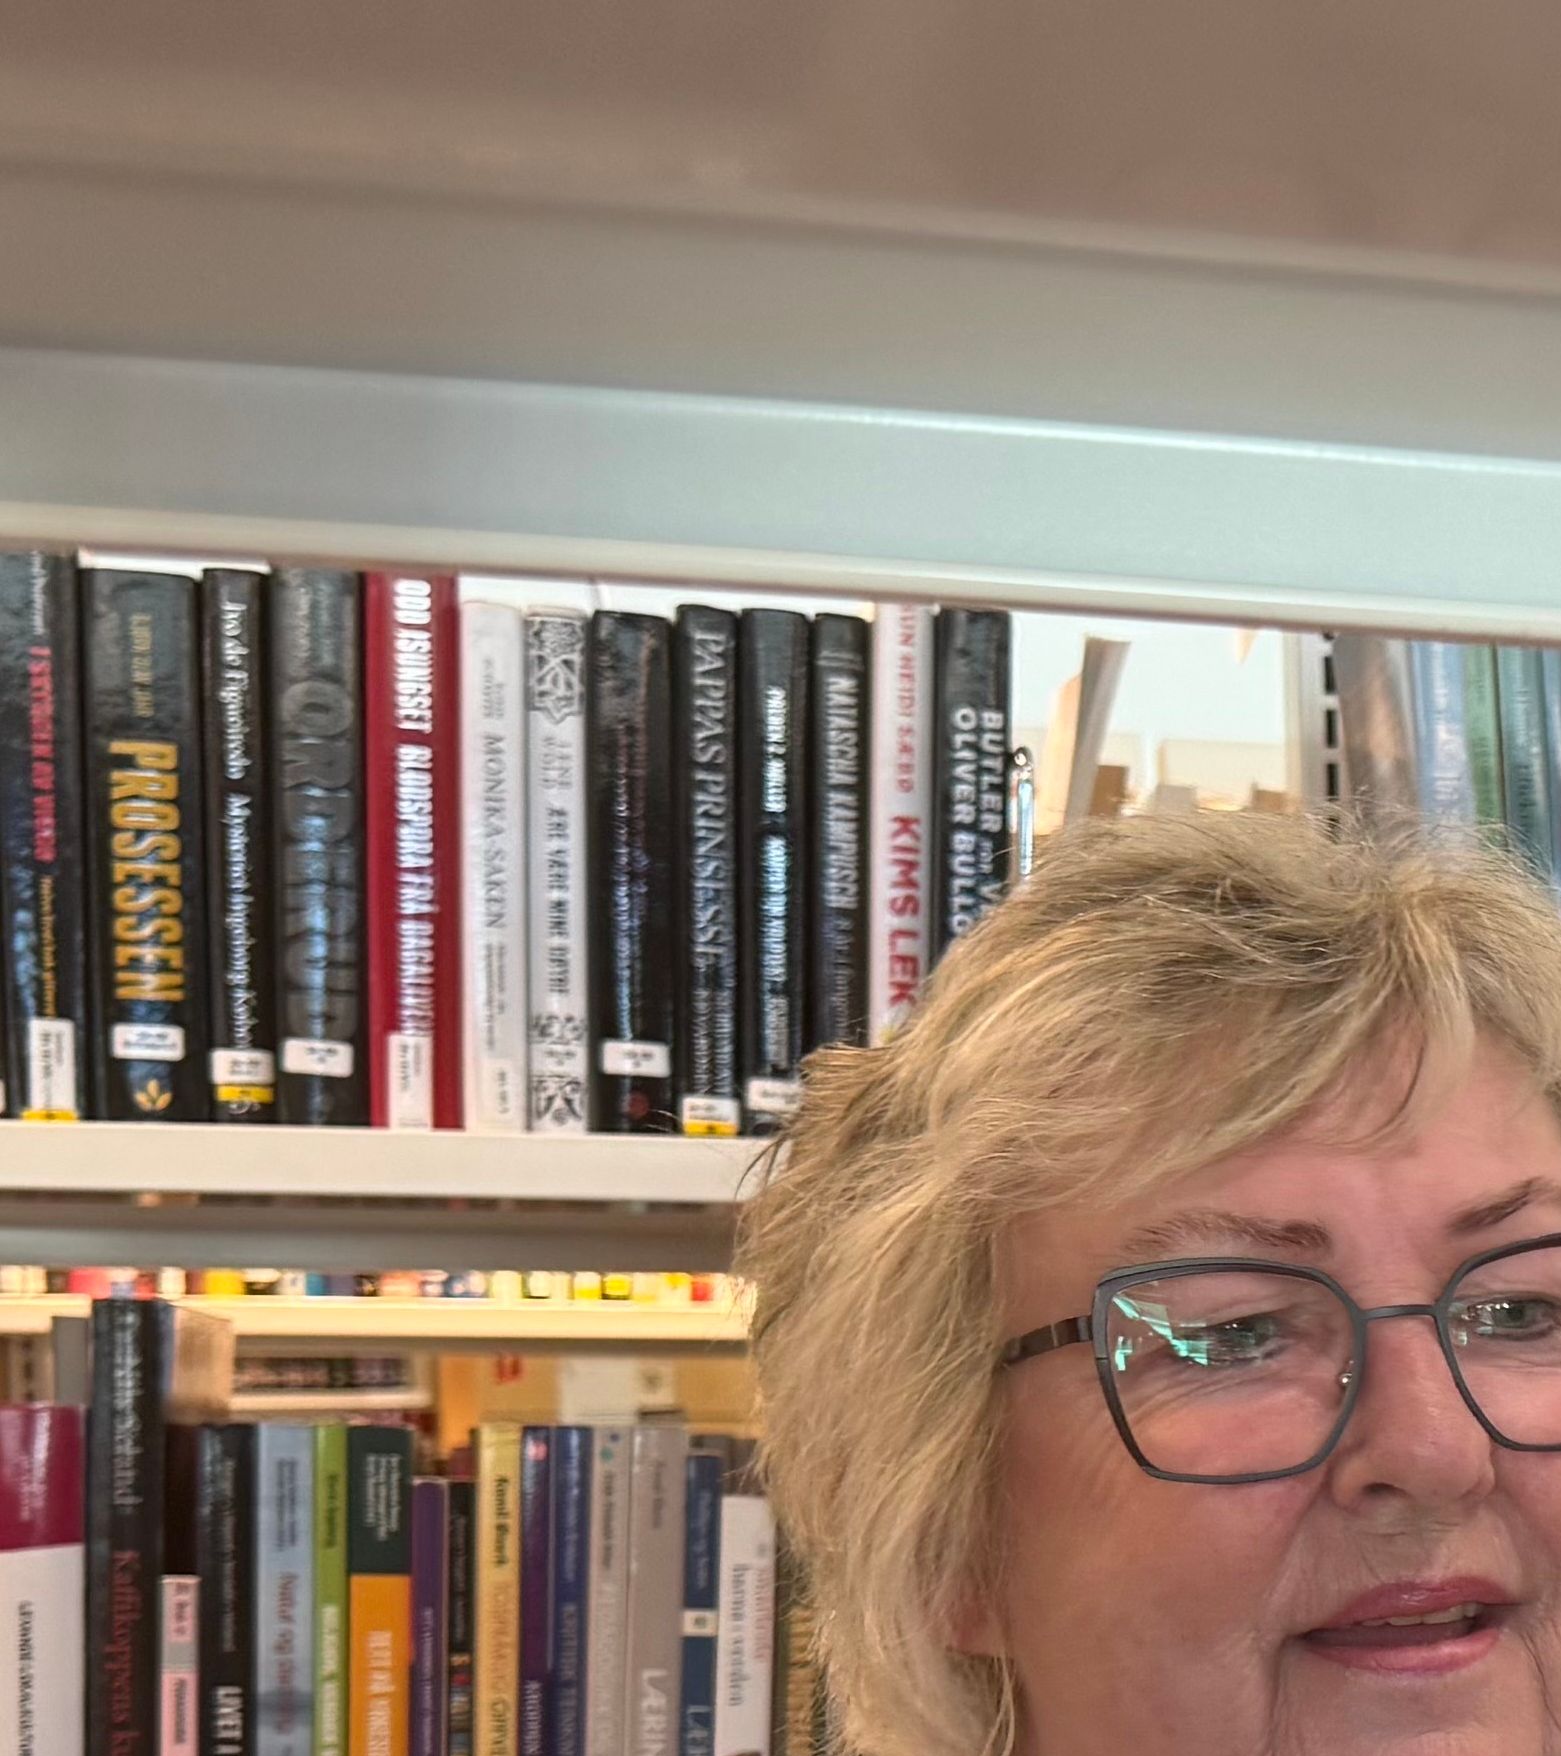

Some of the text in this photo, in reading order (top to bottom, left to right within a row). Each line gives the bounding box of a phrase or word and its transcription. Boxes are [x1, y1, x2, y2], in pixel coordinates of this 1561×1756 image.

[395, 578, 432, 734] ODD ISUNGSET
[692, 630, 729, 763] PAPPAS
[825, 676, 860, 786] NATASCHA
[952, 706, 978, 824] OLIVER
[980, 708, 1004, 832] BUTLER
[107, 740, 186, 1001] PROSESSEN
[692, 768, 730, 968] PRINSESSE
[826, 789, 860, 909] KAMPUSCH
[888, 815, 921, 1007] KIMS LEK
[215, 1685, 243, 1740] LIVET
